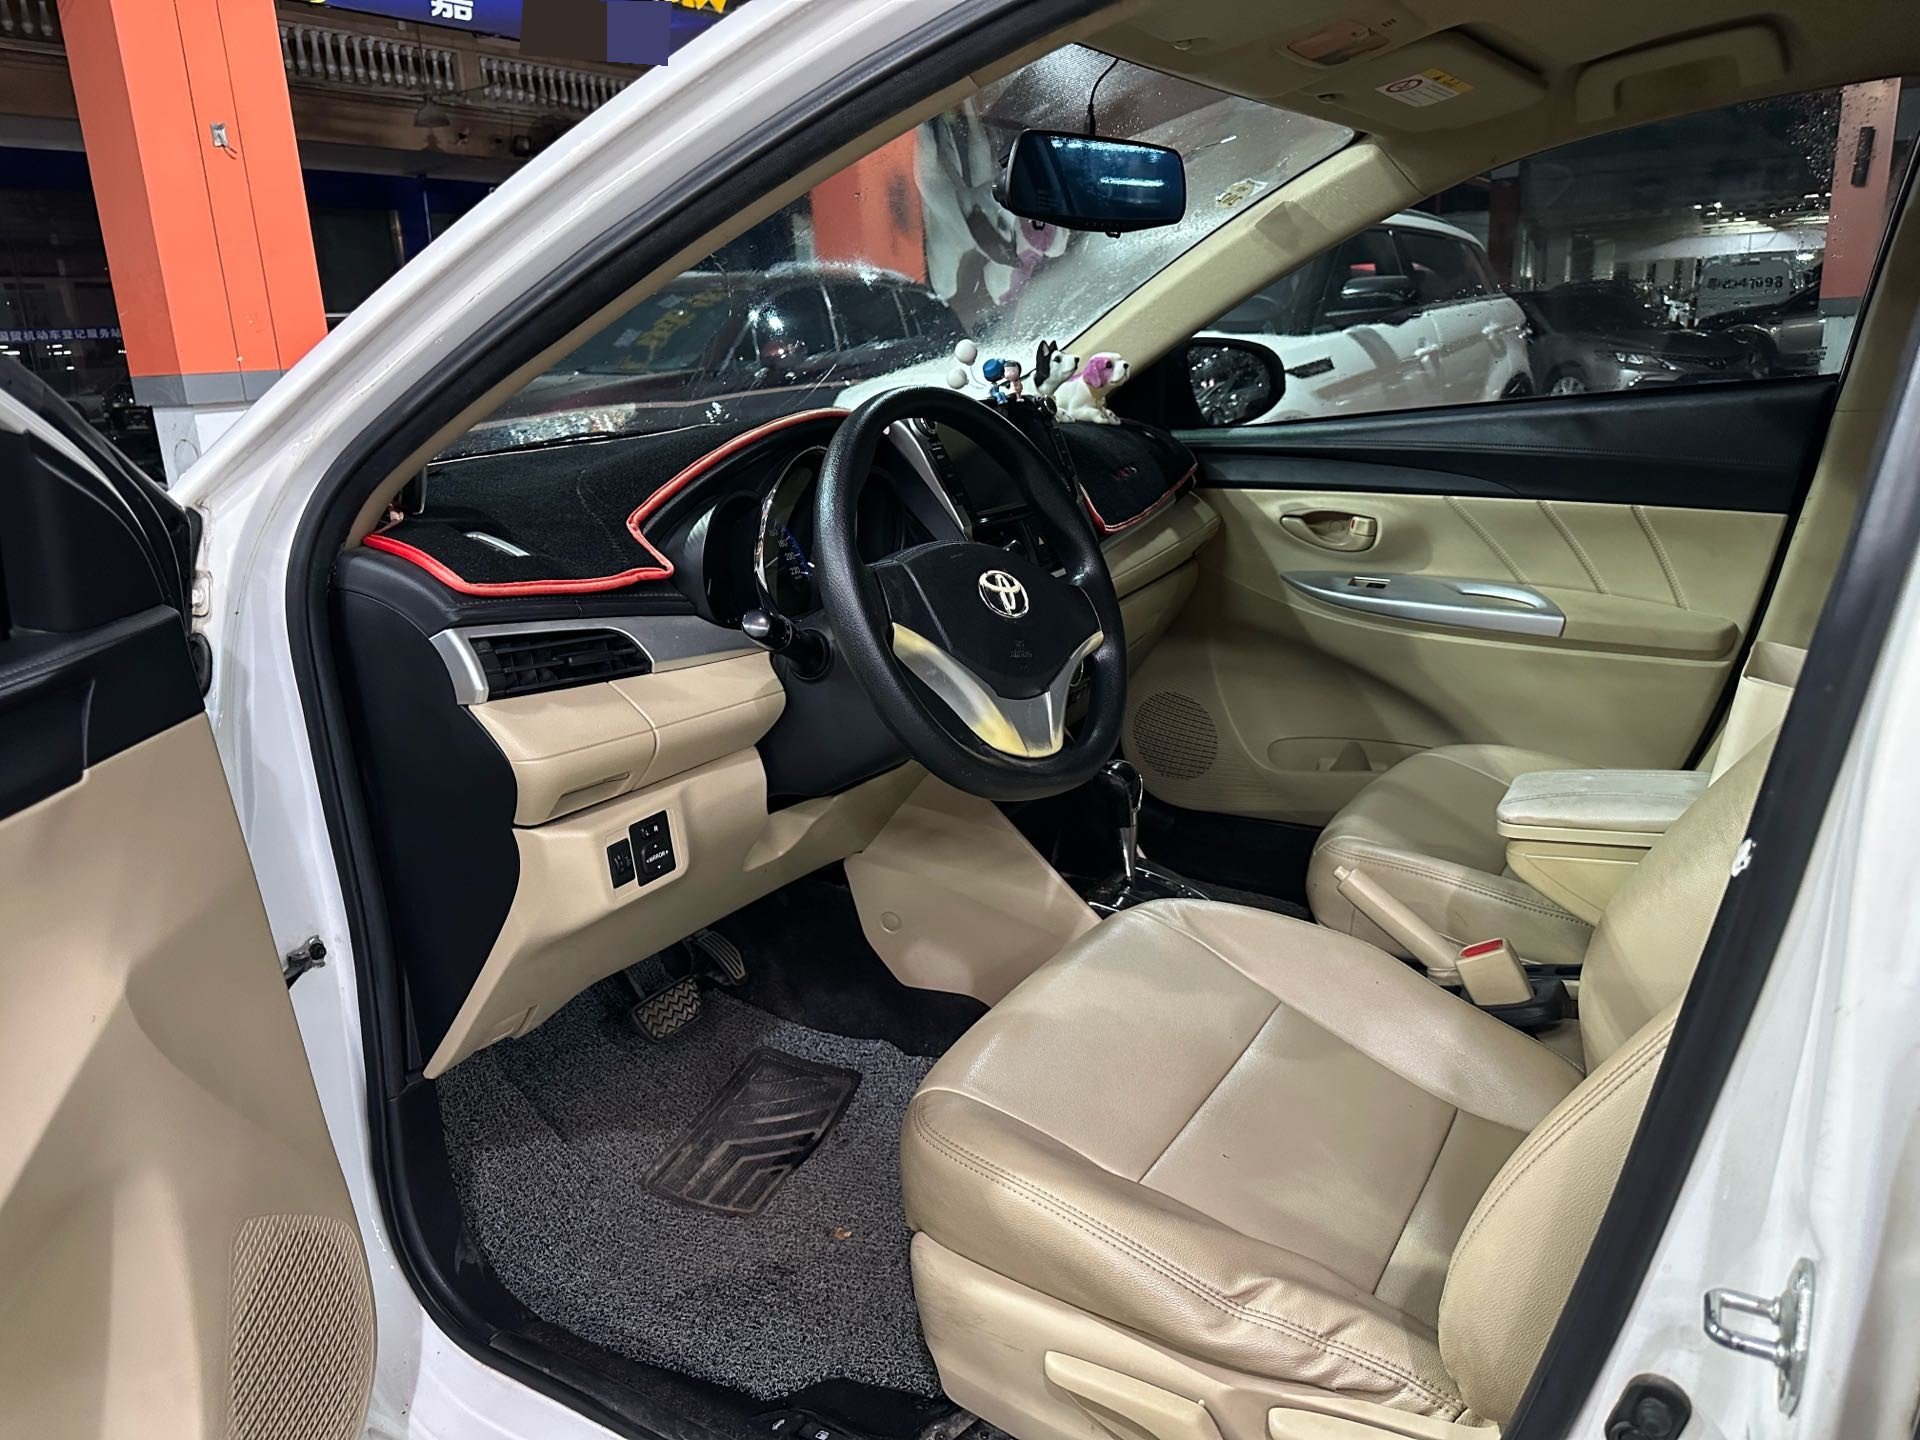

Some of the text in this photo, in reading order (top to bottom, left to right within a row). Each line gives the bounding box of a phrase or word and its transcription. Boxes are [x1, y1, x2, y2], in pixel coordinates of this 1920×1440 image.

[784, 551, 796, 561] 200
[789, 566, 801, 575] 220
[649, 850, 666, 863] MIRROR
